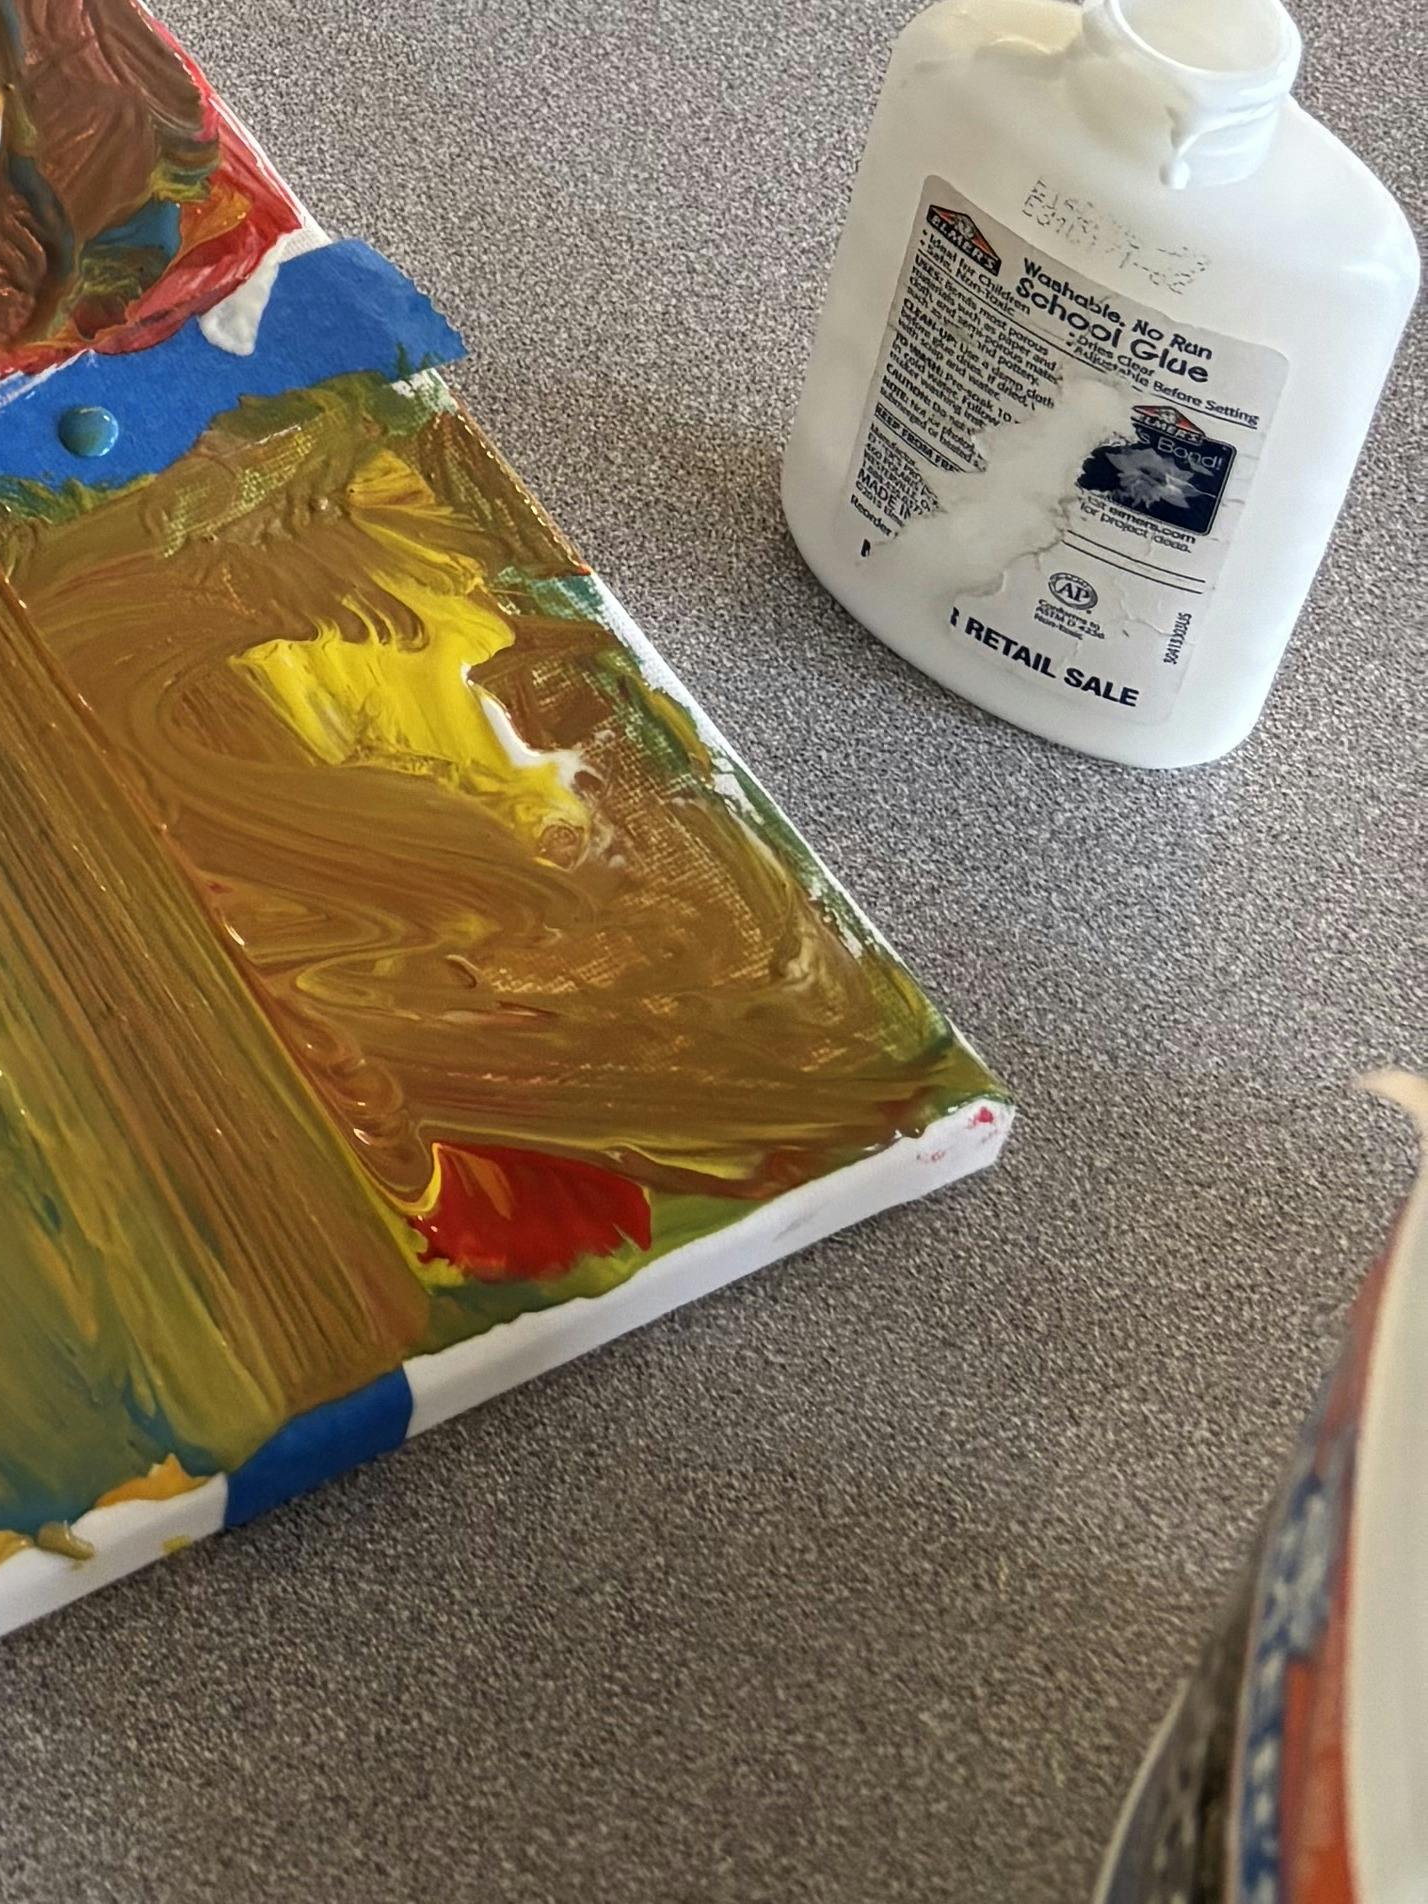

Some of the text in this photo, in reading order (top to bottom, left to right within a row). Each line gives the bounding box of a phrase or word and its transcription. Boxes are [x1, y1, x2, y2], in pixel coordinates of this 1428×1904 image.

[978, 273, 1030, 314] Children
[978, 306, 1007, 331] most
[1007, 326, 1048, 361] porous
[1014, 277, 1123, 347] School
[1129, 338, 1208, 382] Glue
[1131, 318, 1164, 341] No
[1169, 333, 1212, 360] Run
[997, 331, 1030, 356] paper
[1031, 347, 1057, 371] and
[997, 352, 1039, 390] pottery.
[1076, 334, 1155, 376] Dries Clear
[1025, 384, 1054, 408] cloth
[1152, 380, 1197, 405] Before
[1204, 399, 1259, 429] Setting
[857, 468, 897, 509] MADE
[850, 493, 892, 536] Reorder
[1099, 512, 1148, 538] project
[1055, 581, 1090, 602] AP
[965, 617, 1055, 678] RETAIL
[1063, 667, 1138, 706] SALE
